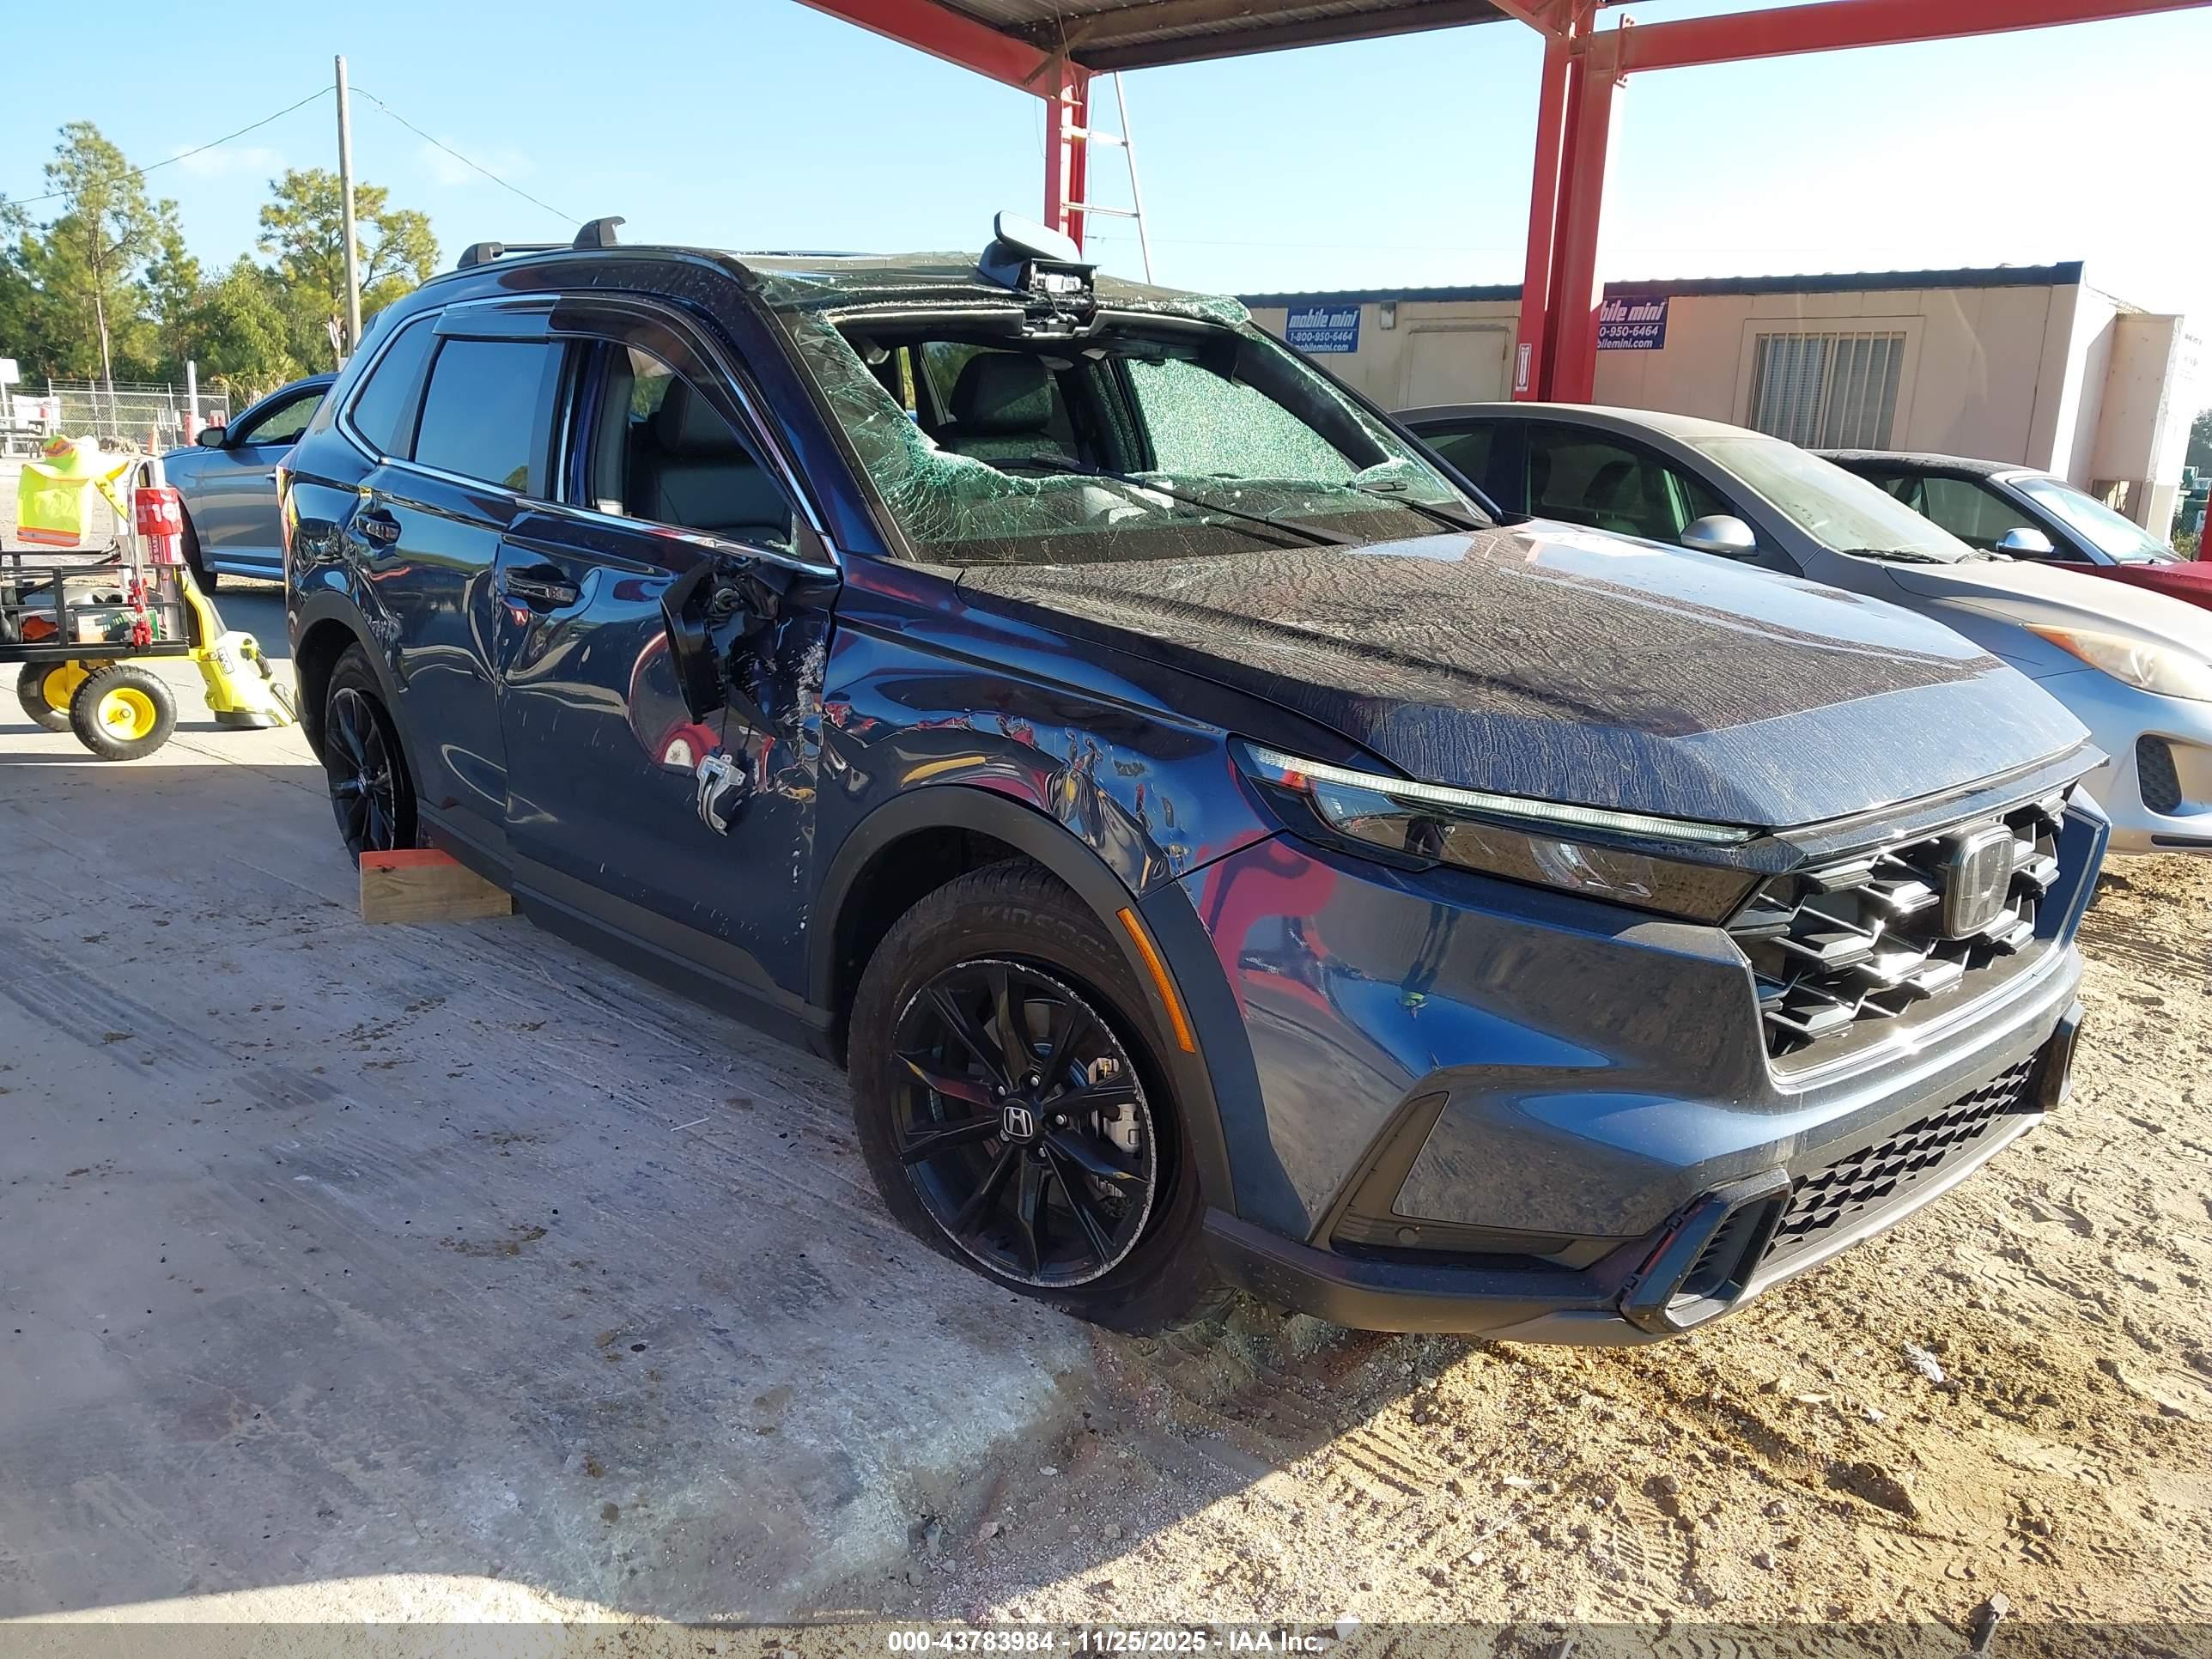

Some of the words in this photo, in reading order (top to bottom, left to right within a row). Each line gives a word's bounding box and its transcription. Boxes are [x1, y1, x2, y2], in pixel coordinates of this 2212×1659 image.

[1600, 300, 1627, 322] bile
[1628, 301, 1666, 321] mini
[1290, 308, 1328, 328] mobile
[1328, 310, 1358, 327] mini
[1291, 331, 1353, 341] 1-800-950-6464
[1600, 325, 1658, 337] 0-950-6464
[1596, 337, 1653, 348] bilemini.com
